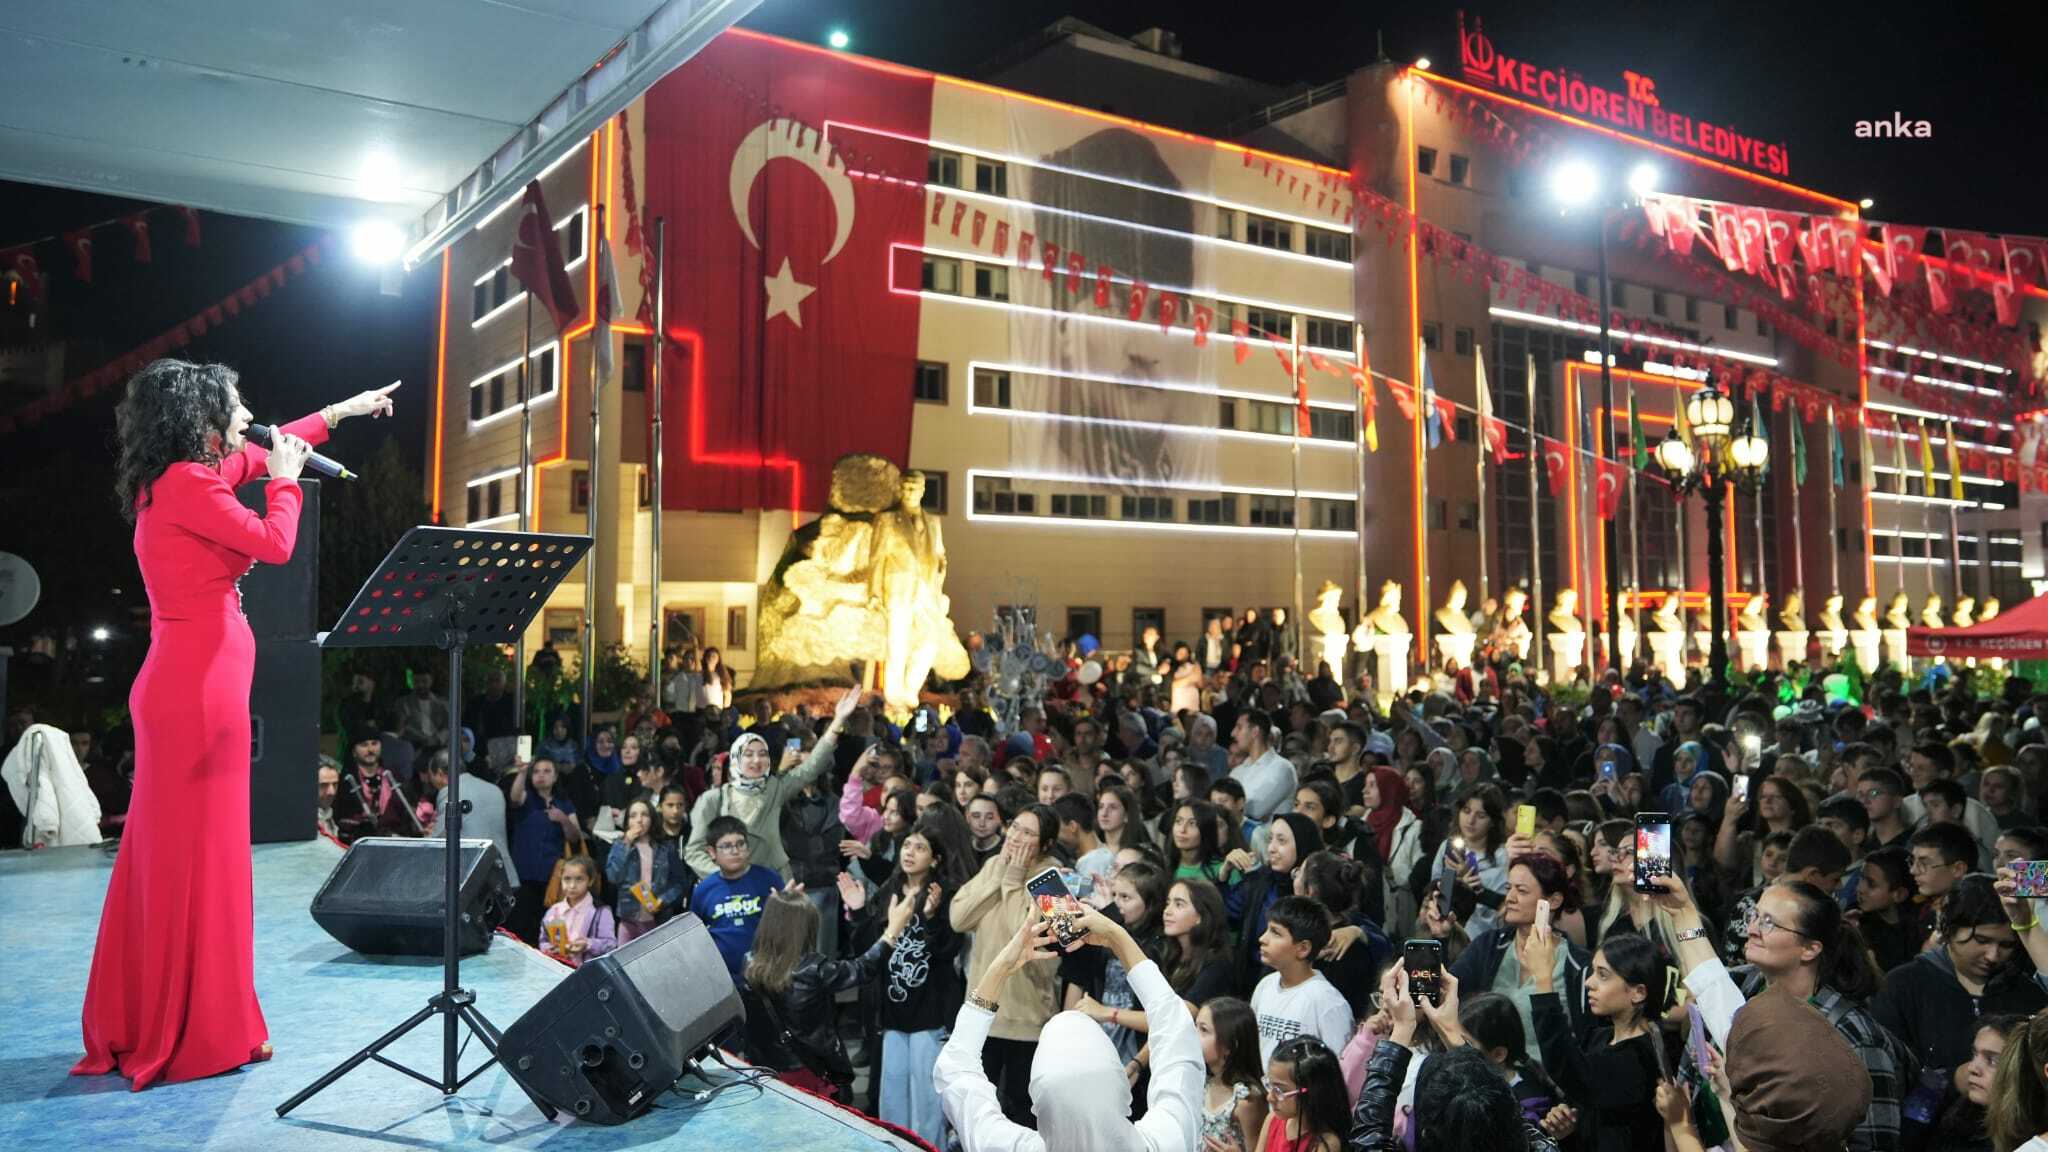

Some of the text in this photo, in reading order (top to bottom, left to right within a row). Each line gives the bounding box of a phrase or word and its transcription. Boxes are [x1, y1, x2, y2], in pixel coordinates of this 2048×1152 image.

[1497, 54, 1789, 176] KEÇİÖREN BELEDİYESİ
[714, 899, 762, 916] SEOUL
